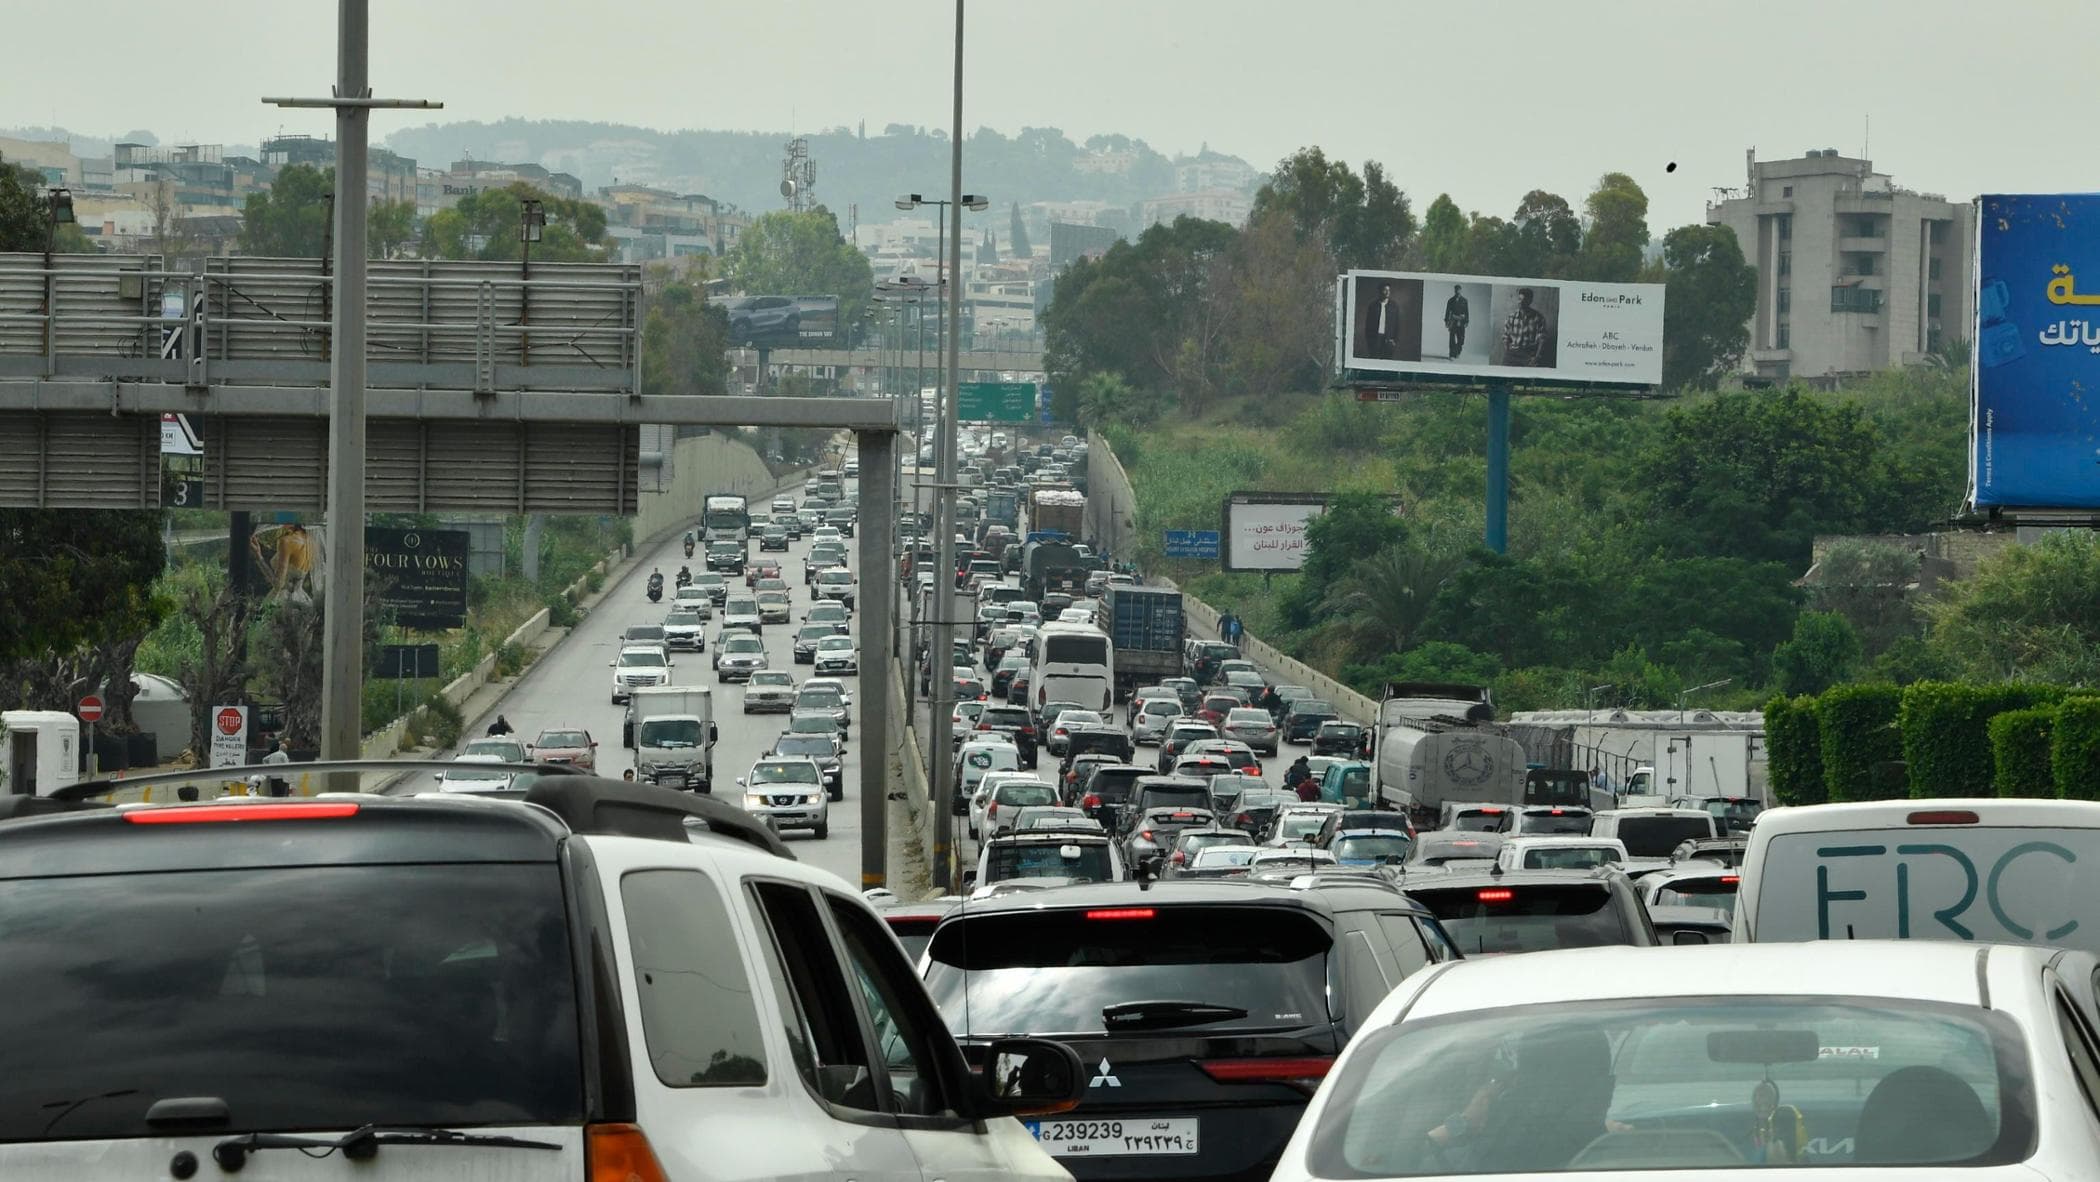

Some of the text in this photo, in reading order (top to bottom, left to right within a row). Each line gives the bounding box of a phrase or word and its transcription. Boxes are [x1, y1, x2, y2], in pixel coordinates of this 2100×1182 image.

[443, 184, 477, 195] Bank
[1581, 293, 1642, 305] Eden Park
[1602, 332, 1619, 340] ABC
[364, 553, 463, 569] FOUR VOWS
[219, 716, 240, 726] STOP
[1042, 1122, 1122, 1141] G 239239
[1151, 1122, 1169, 1130] لبنان
[1124, 1135, 1183, 1151] ٢٣٩٢٣٩
